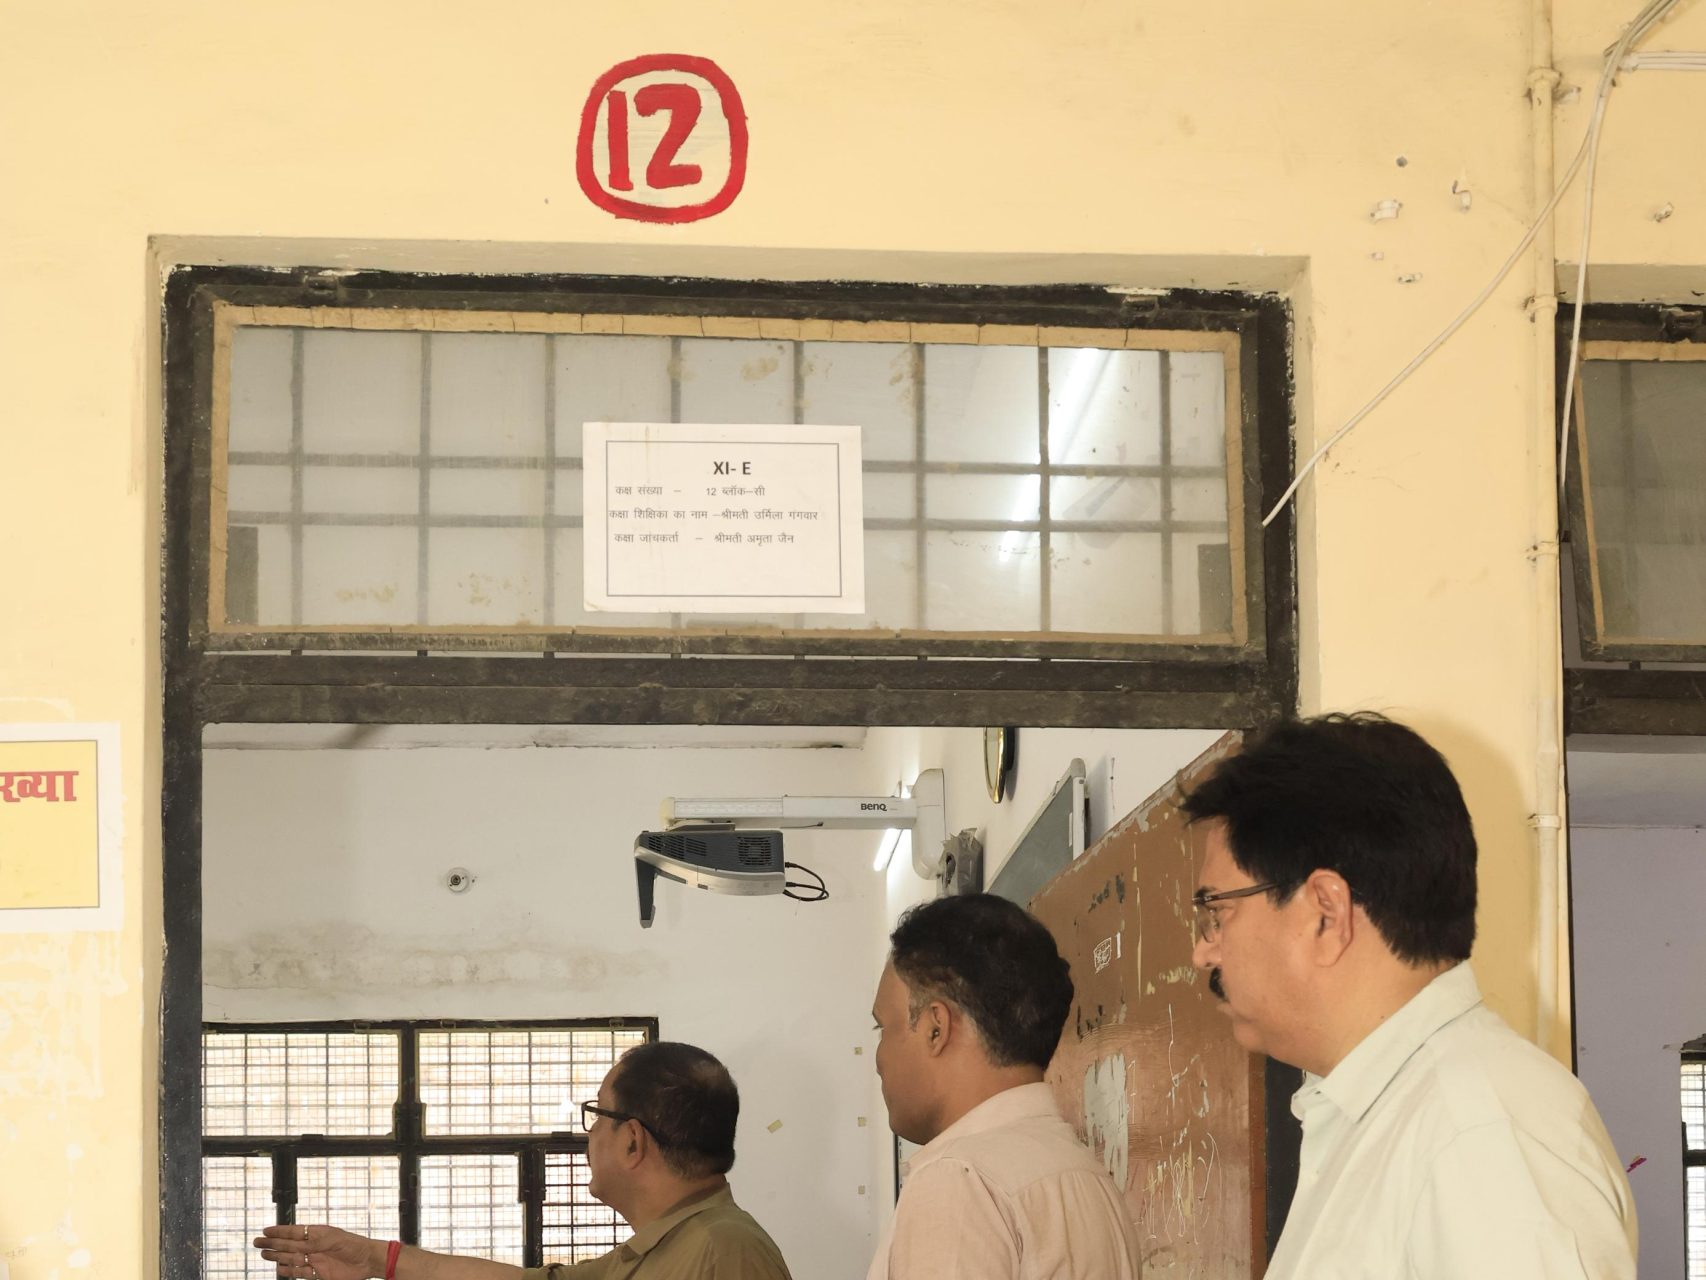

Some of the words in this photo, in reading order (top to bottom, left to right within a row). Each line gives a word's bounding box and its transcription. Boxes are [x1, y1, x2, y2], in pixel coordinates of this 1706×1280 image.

[606, 83, 703, 191] 12
[741, 460, 752, 476] E
[615, 486, 633, 496] कक्ष
[637, 484, 664, 496] संख्या
[706, 487, 717, 497] 12
[608, 509, 630, 519] कक्षा
[633, 506, 669, 520] शिक्षिका
[672, 510, 686, 520] का
[690, 510, 708, 520] नाम
[752, 508, 784, 521] उर्मिला
[614, 533, 635, 544] कक्षा
[713, 531, 743, 544] श्रीमती
[746, 534, 773, 547] अमृता
[776, 531, 795, 544] जैन
[0, 770, 79, 803] ख्या
